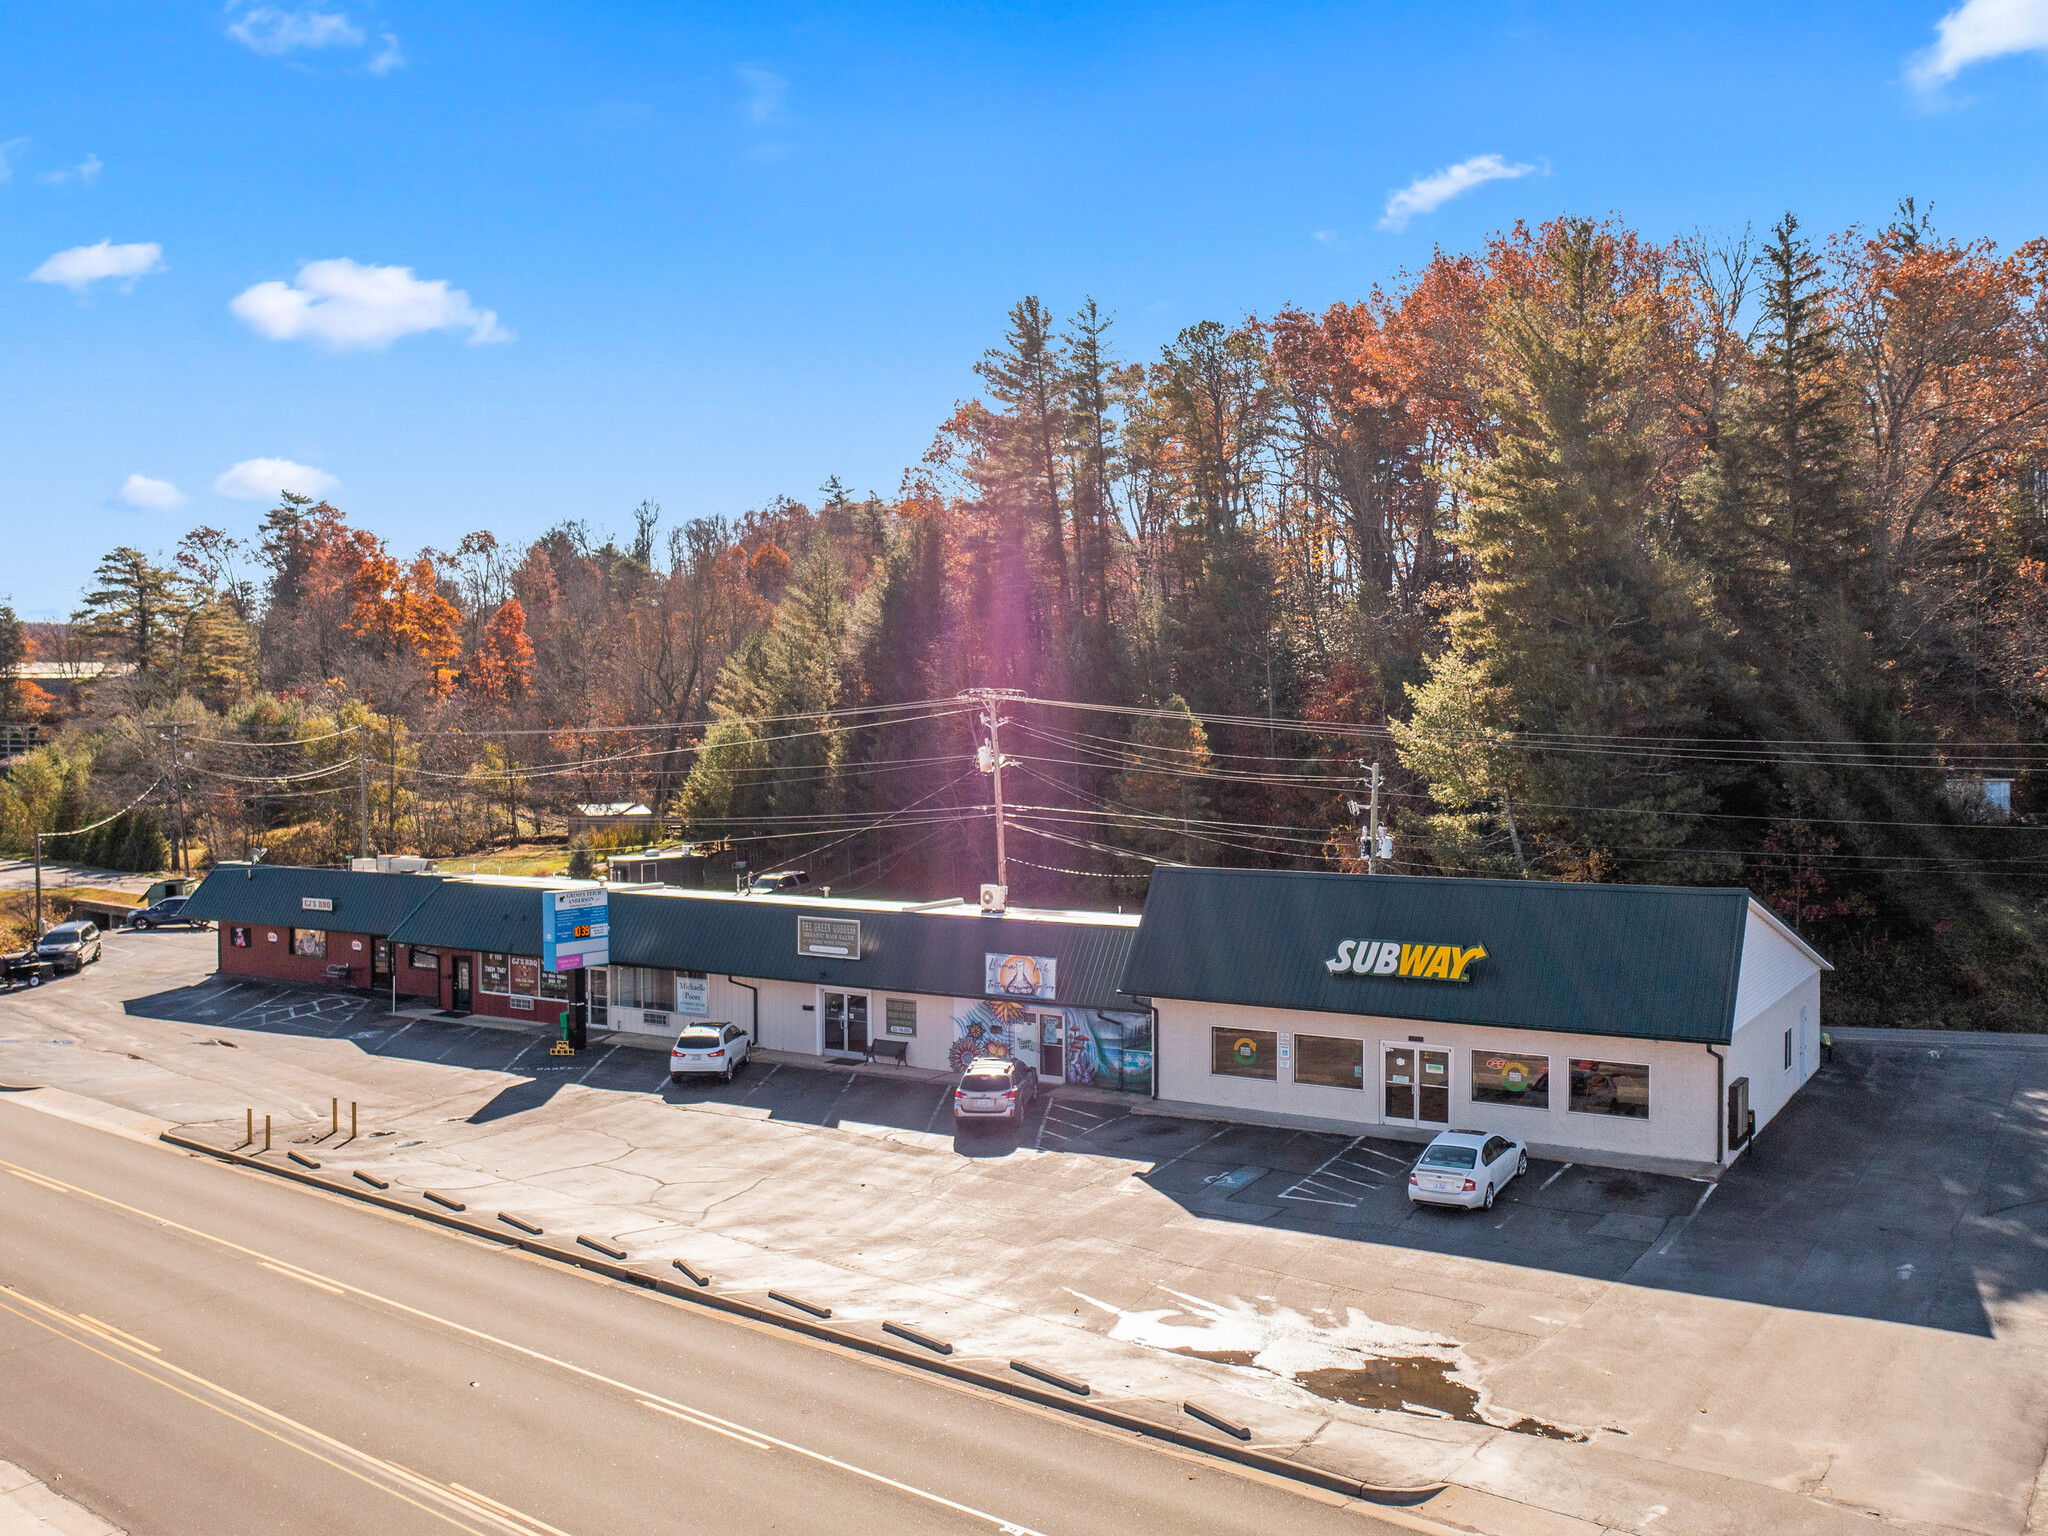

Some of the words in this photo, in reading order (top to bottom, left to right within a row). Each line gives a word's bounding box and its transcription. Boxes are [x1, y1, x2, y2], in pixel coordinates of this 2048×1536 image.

[304, 899, 317, 908] CJ'S
[318, 900, 331, 909] BBQ
[568, 896, 594, 904] ANDERSON
[813, 922, 831, 933] GREEN
[832, 924, 856, 935] GODDESS
[511, 957, 524, 966] CJ'S
[524, 959, 538, 968] BBQ
[1326, 940, 1486, 979] SUBWAY
[684, 992, 701, 1001] Poore
